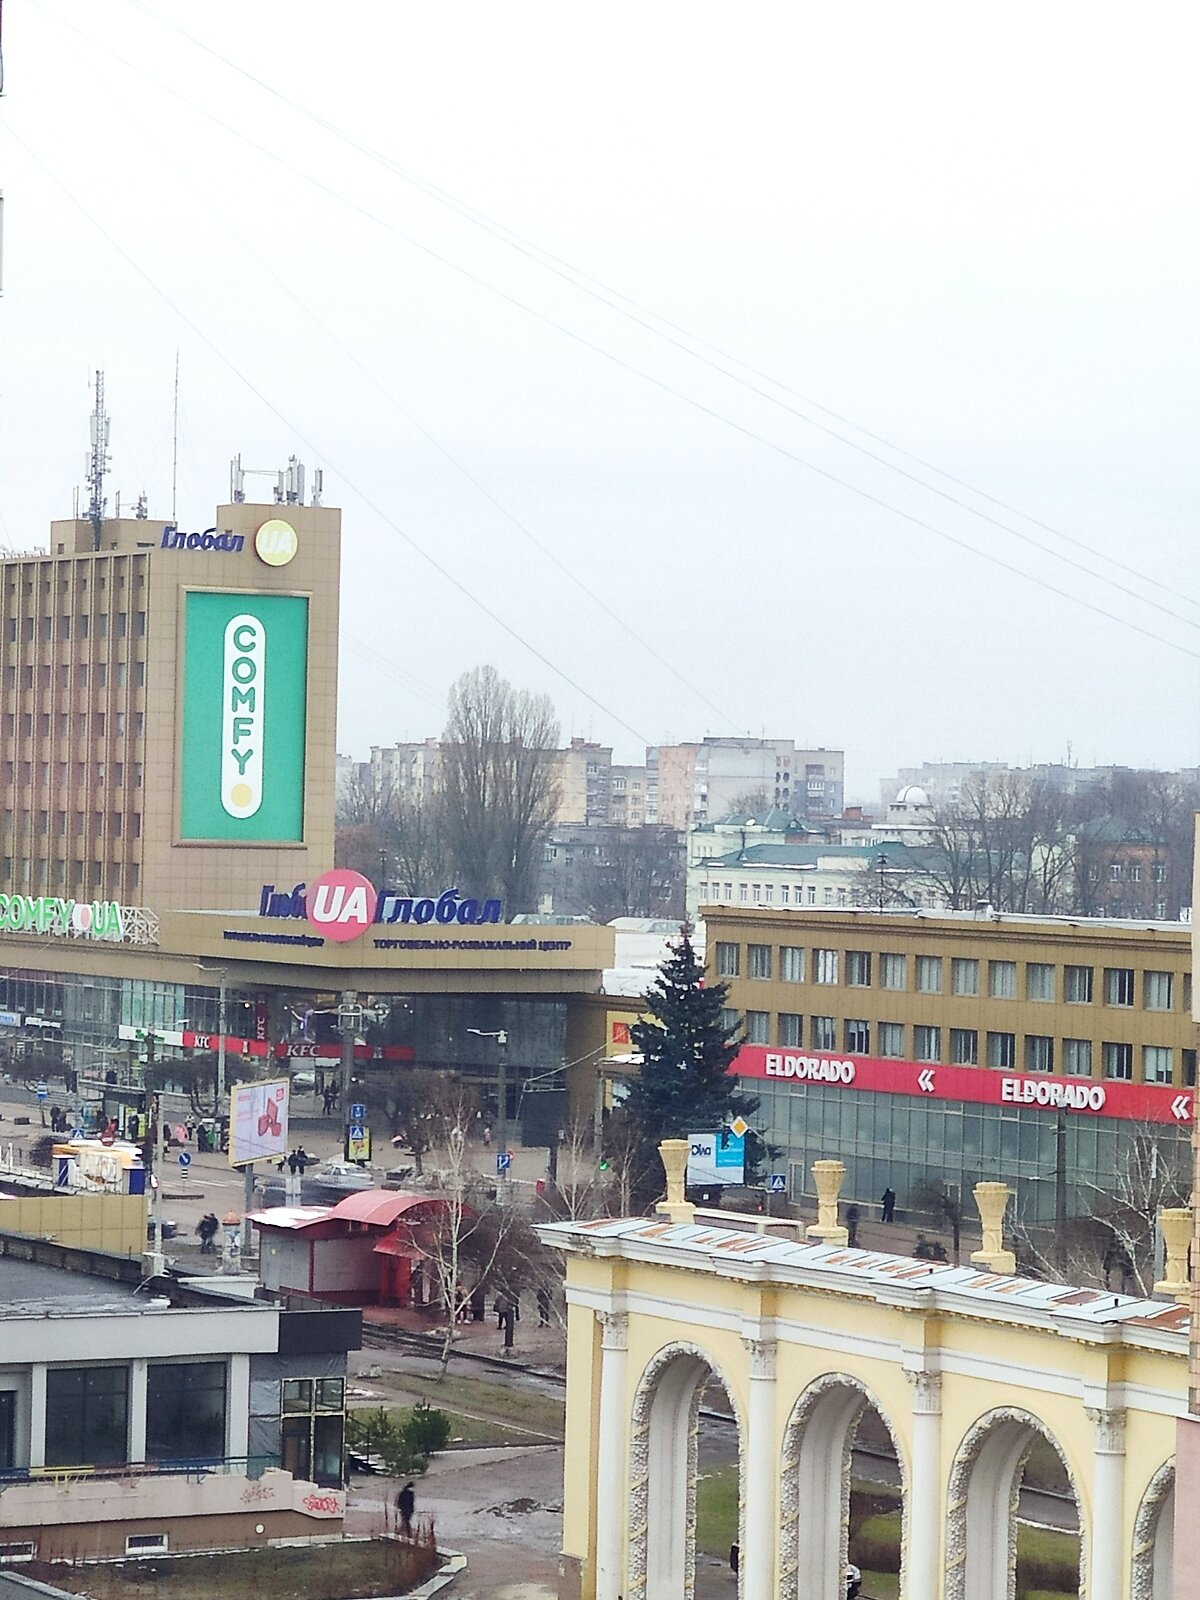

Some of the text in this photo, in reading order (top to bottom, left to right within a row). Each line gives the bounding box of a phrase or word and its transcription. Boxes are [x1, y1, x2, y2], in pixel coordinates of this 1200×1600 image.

[161, 526, 245, 552] Глобал
[261, 530, 293, 554] UA
[231, 625, 257, 776] COMFY
[259, 882, 308, 920] Глоб
[312, 885, 368, 924] UA
[374, 888, 502, 925] Глобал
[92, 900, 122, 938] UA
[194, 1035, 211, 1049] KFC
[257, 1016, 266, 1040] KFC
[286, 1045, 321, 1057] KFC
[765, 1053, 855, 1085] ELDORADO
[1001, 1077, 1106, 1112] ELDORADO
